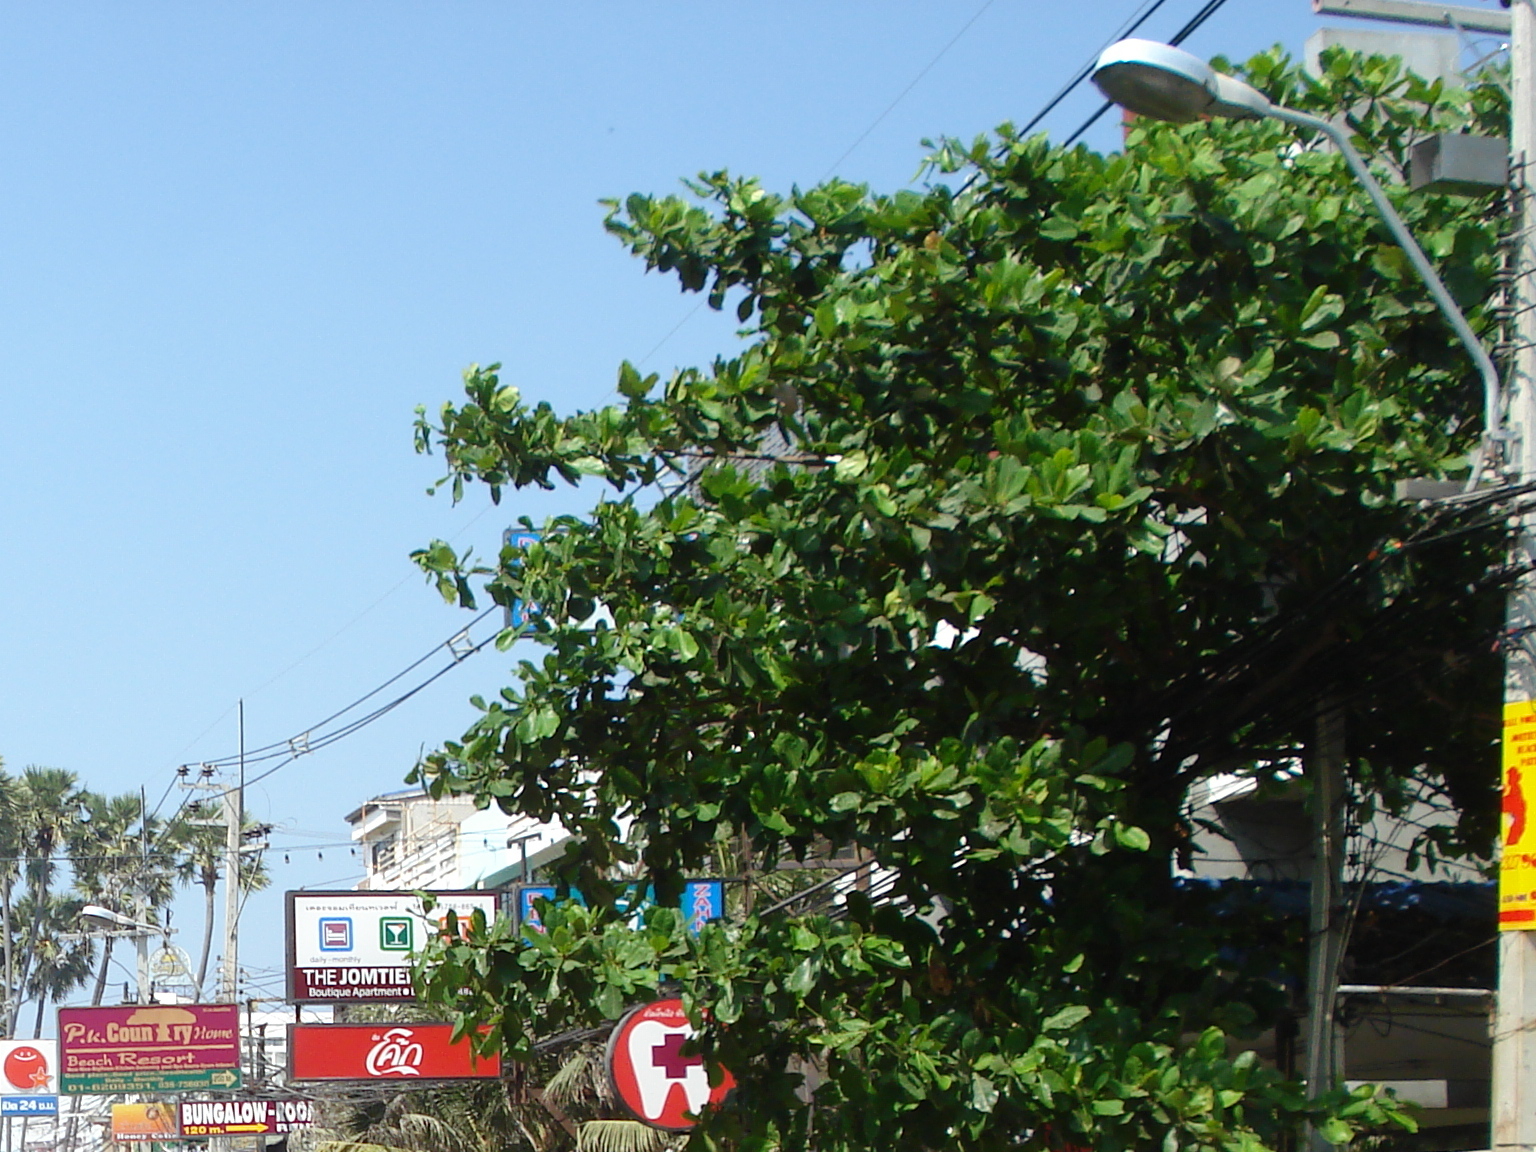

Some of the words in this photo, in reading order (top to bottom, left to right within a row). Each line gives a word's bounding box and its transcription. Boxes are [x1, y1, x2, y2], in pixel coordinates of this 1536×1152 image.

[303, 968, 337, 986] THE
[308, 986, 351, 998] Boutique
[352, 987, 402, 998] Apartment
[67, 1053, 113, 1068] Beach
[117, 1052, 196, 1066] Resort
[19, 1099, 38, 1111] 24
[183, 1126, 206, 1134] 120
